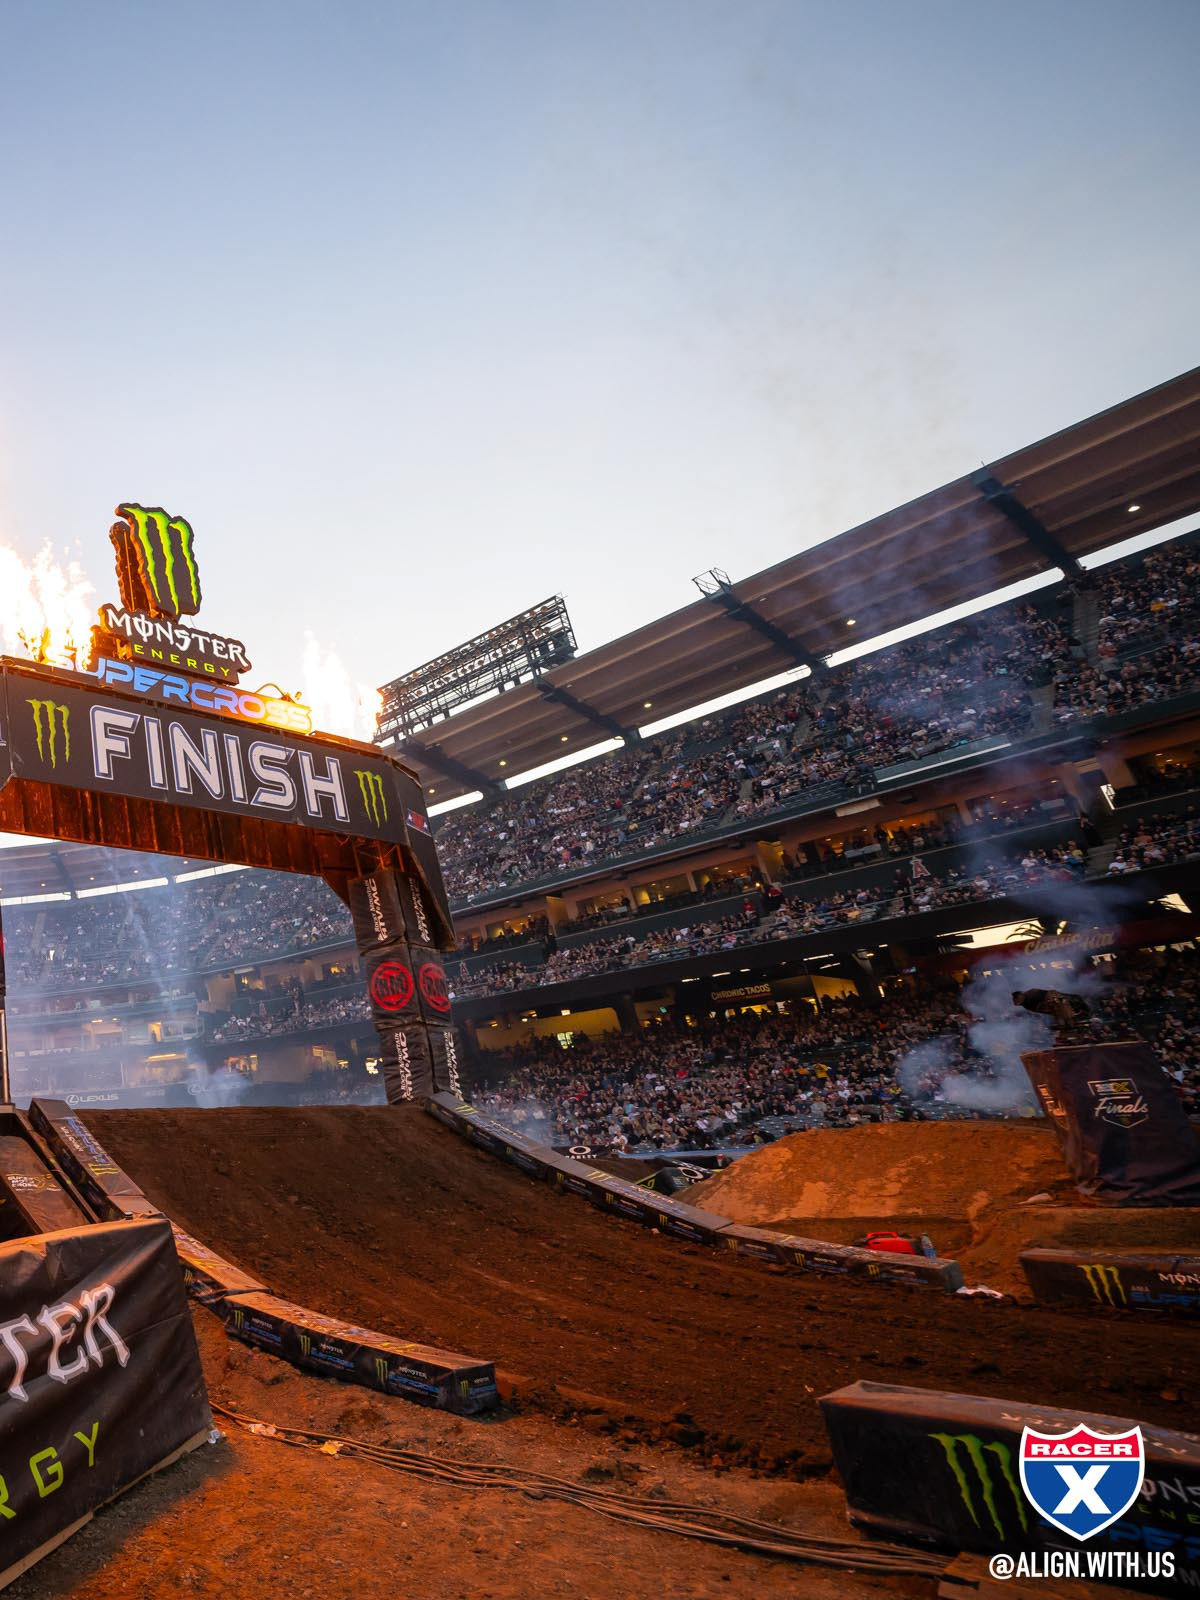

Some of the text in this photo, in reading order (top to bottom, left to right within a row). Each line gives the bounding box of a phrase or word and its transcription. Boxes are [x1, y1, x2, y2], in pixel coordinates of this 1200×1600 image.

[106, 608, 249, 667] MONSTER
[134, 644, 230, 677] ENERGY
[44, 646, 313, 733] SUPERCROSS
[89, 704, 350, 822] FINISH
[711, 983, 771, 1000] CHRONIC TACOS
[80, 1093, 120, 1103] LEXUS
[1094, 1095, 1149, 1118] Finals
[1158, 1272, 1200, 1286] MON
